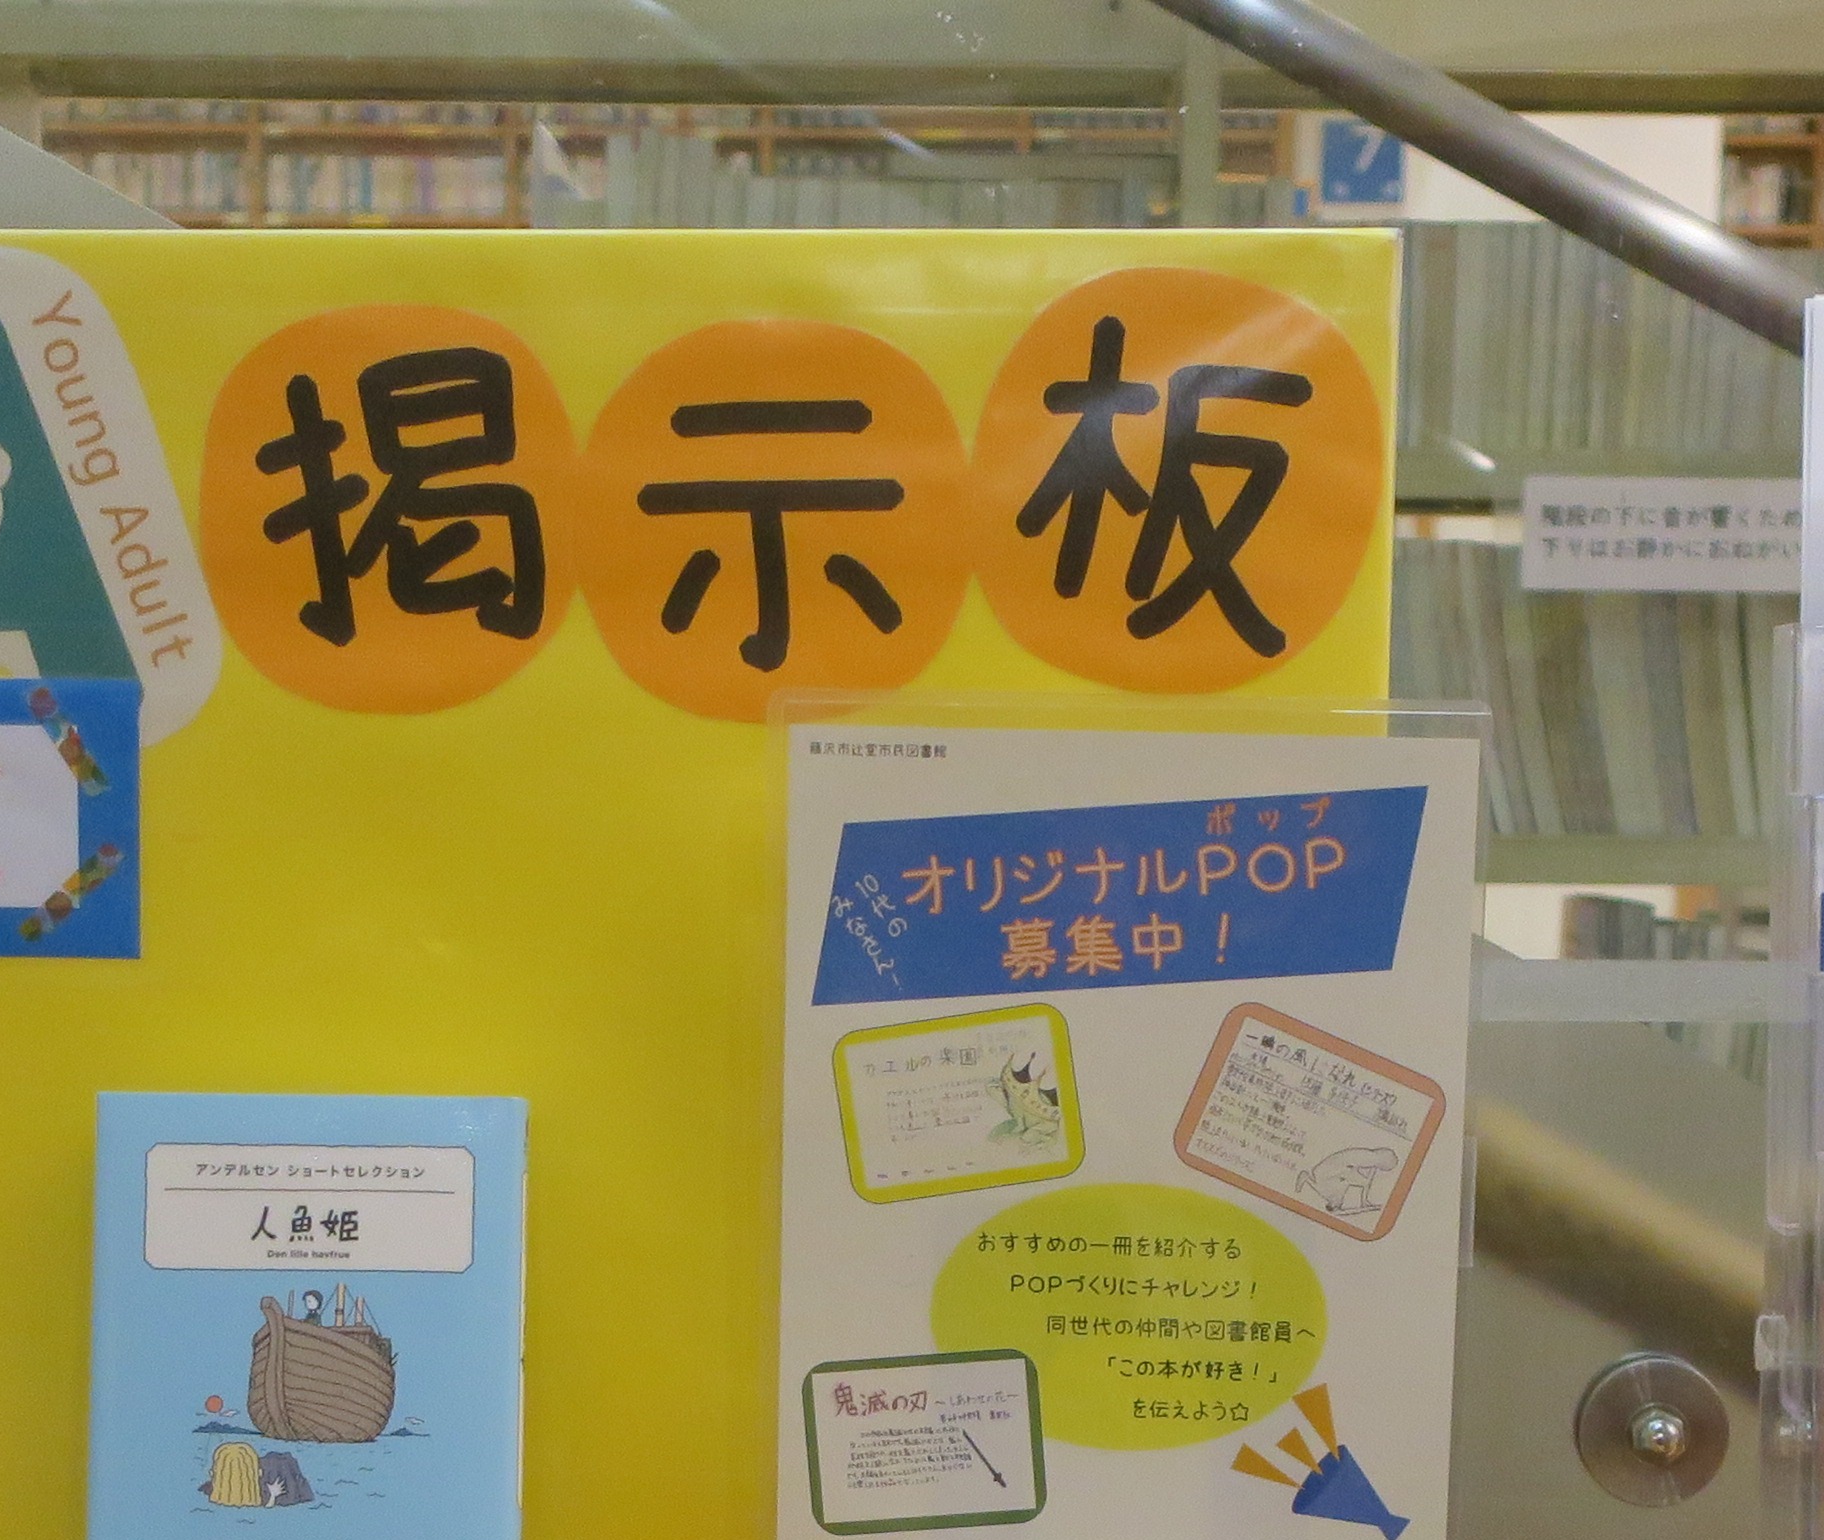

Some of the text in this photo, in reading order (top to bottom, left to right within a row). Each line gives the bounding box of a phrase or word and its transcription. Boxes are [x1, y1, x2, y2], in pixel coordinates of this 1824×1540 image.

[31, 290, 191, 668] Young Adult
[255, 314, 1312, 673] 掲示板
[810, 741, 947, 758] 藤沢市辻堂市民図書館
[1205, 798, 1333, 834] ポップ
[900, 836, 1345, 914] オリジナルPOP
[855, 874, 908, 937] 10代の
[195, 1163, 426, 1179] アンデルセン ショートセレクション
[250, 1205, 360, 1242] 人魚姫
[977, 1232, 1242, 1260] おすすめの一冊を紹介する
[1046, 1314, 1316, 1345] 同世代の仲間や図書館員へ
[834, 1381, 928, 1416] 鬼滅の刃
